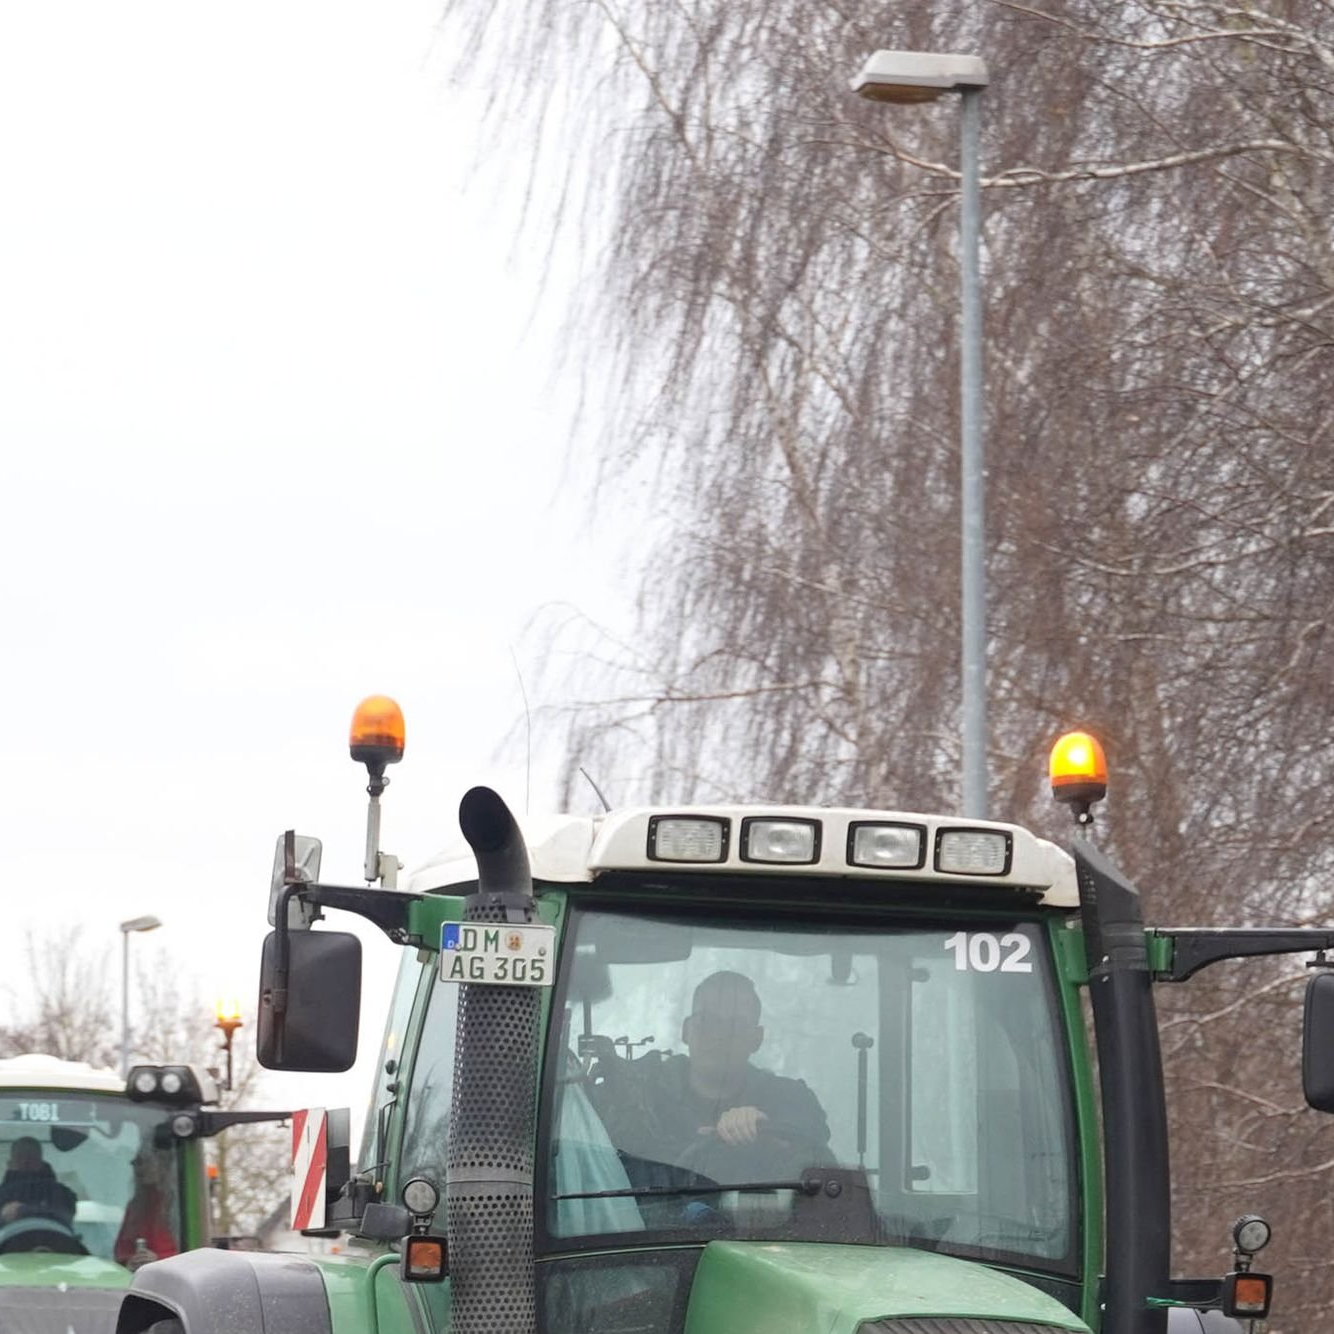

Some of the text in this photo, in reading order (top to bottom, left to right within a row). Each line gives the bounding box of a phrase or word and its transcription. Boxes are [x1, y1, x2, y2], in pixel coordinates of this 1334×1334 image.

[462, 928, 499, 953] DM
[944, 931, 1032, 973] 102
[450, 956, 545, 982] AG 305
[19, 1103, 59, 1121] TOBI
